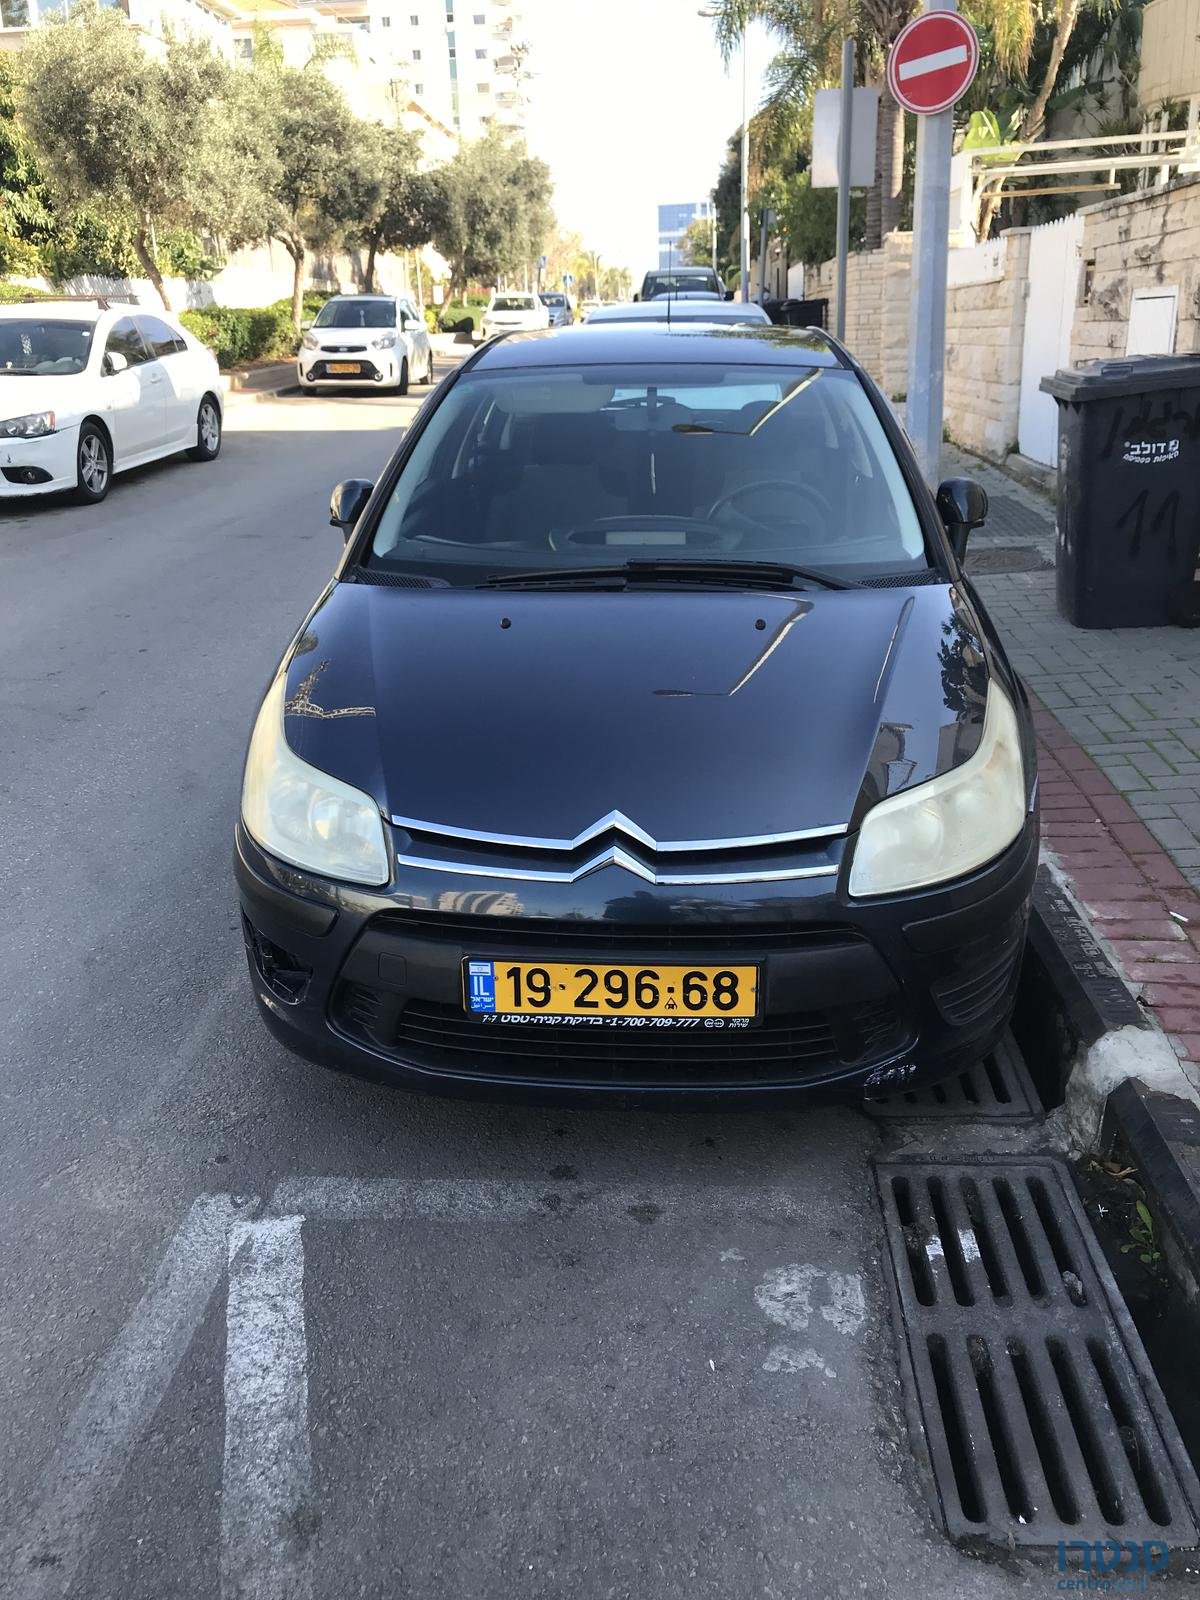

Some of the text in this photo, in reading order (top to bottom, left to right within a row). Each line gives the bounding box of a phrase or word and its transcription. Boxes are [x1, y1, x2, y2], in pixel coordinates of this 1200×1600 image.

[1130, 441, 1166, 455] דולב
[473, 975, 490, 996] IL
[507, 966, 551, 1008] 19
[682, 970, 739, 1011] 68
[562, 1017, 603, 1025] בדיקת
